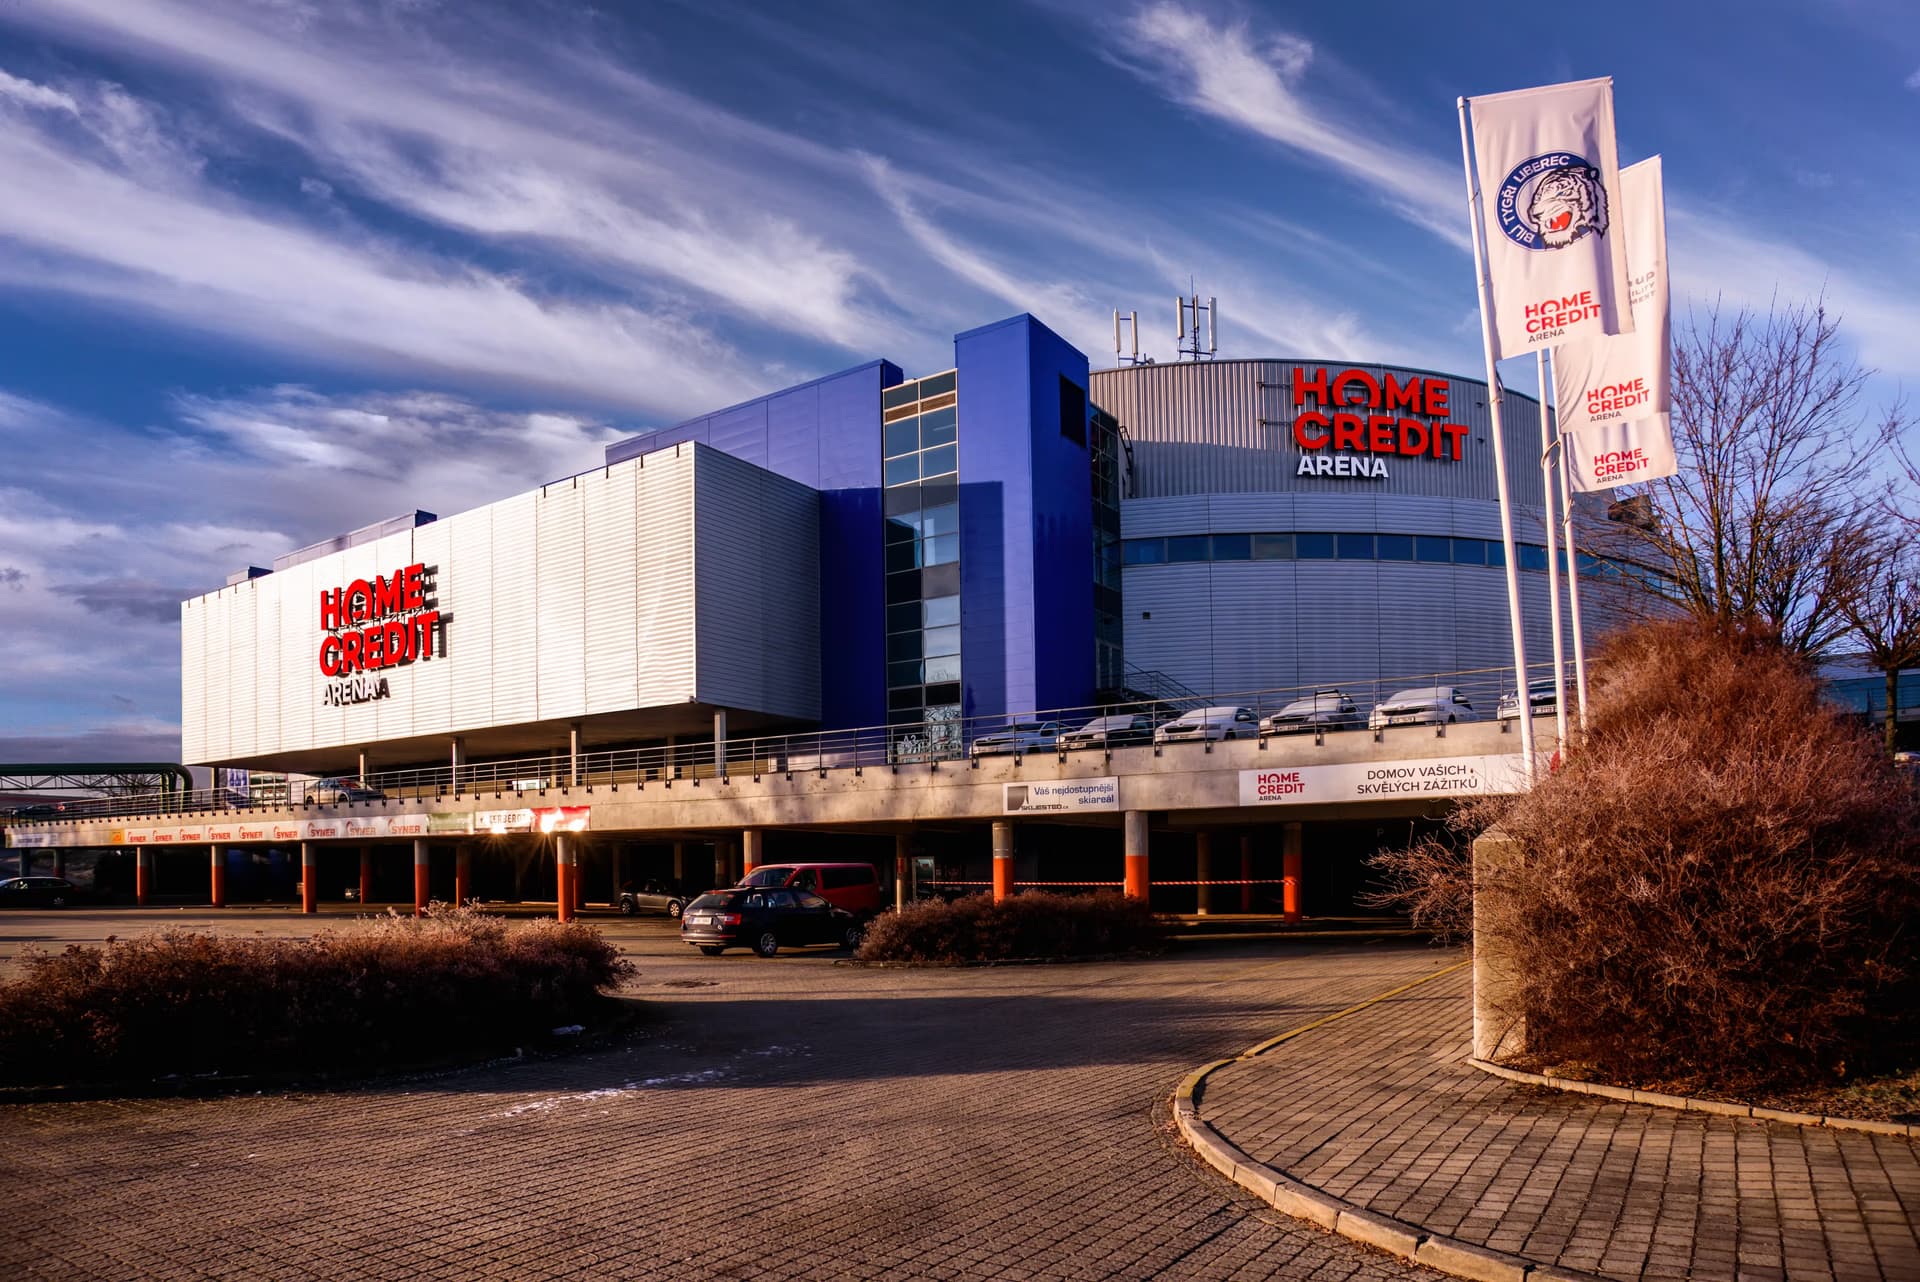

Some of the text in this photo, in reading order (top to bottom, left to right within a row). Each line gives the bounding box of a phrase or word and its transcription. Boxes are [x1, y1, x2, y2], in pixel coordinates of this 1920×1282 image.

[1501, 185, 1517, 225] TYGŘI
[1513, 155, 1570, 184] LIBEREC
[1525, 291, 1592, 318] HOME
[1526, 304, 1601, 333] CREDIT
[1528, 328, 1565, 343] ARENA
[1293, 367, 1449, 417] HOME
[1587, 377, 1644, 402] HOME
[1587, 389, 1650, 415] CREDIT
[1590, 411, 1622, 422] ARENA
[1294, 411, 1469, 461] CREDIT
[1297, 456, 1389, 478] ARENA
[1594, 448, 1643, 465] HOME
[1594, 457, 1649, 477] CREDIT
[1596, 473, 1624, 484] ARENA
[321, 563, 425, 630] HOME
[319, 611, 440, 677] CREDIT
[324, 676, 379, 706] ARENA
[1257, 772, 1300, 784] HOME
[1367, 764, 1466, 780] DOMOV VAŠICH
[1257, 783, 1305, 795] CREDIT
[1357, 776, 1478, 794] SKVĚLÝCH ZÁŽITKŮ
[211, 832, 231, 840] SYNER
[241, 831, 263, 839] SYNER
[275, 830, 298, 839] SYNER
[310, 828, 336, 837] SYNER
[350, 827, 376, 836] SYNER
[391, 825, 420, 835] SYNER
